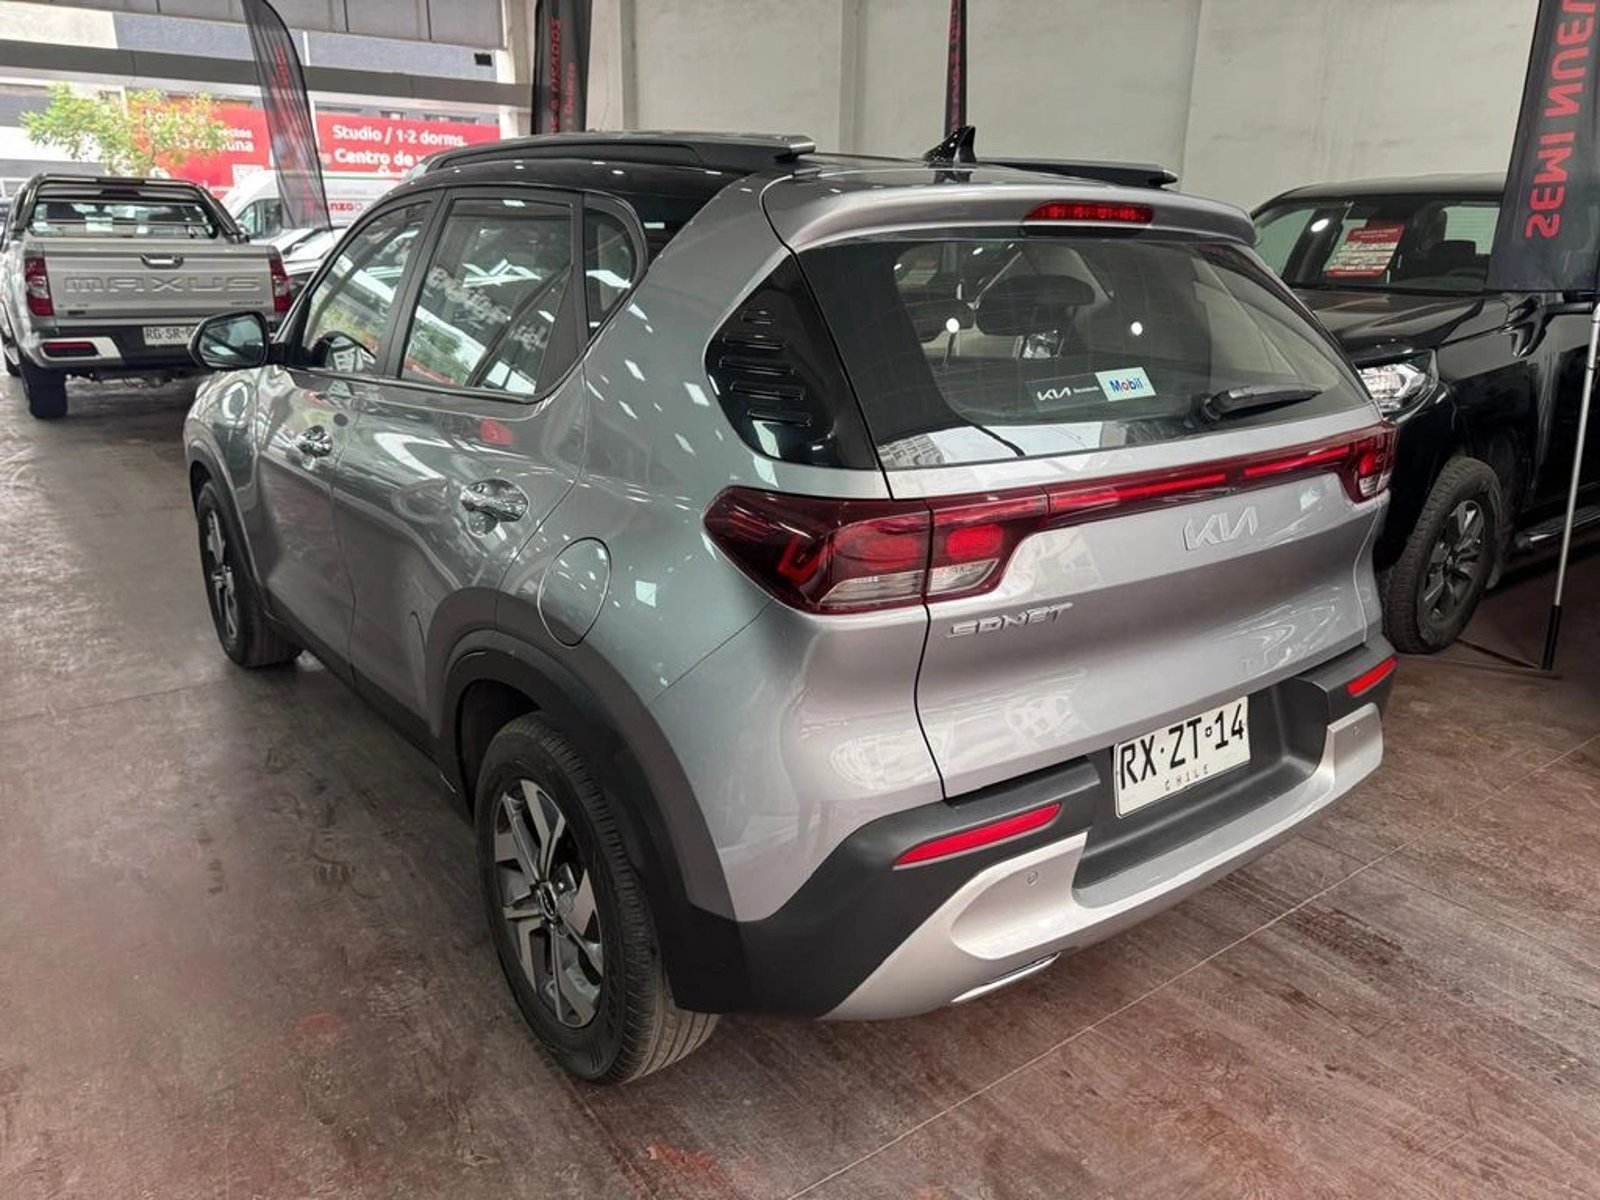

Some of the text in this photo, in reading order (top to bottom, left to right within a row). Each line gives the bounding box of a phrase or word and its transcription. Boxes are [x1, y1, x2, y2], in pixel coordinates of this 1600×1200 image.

[332, 124, 383, 142] Studio
[334, 148, 392, 166] Centro
[393, 150, 415, 167] de
[64, 276, 262, 294] MAXUS
[1109, 377, 1145, 393] Mobil
[946, 602, 1074, 638] SONET
[1164, 763, 1210, 791] CHILE
